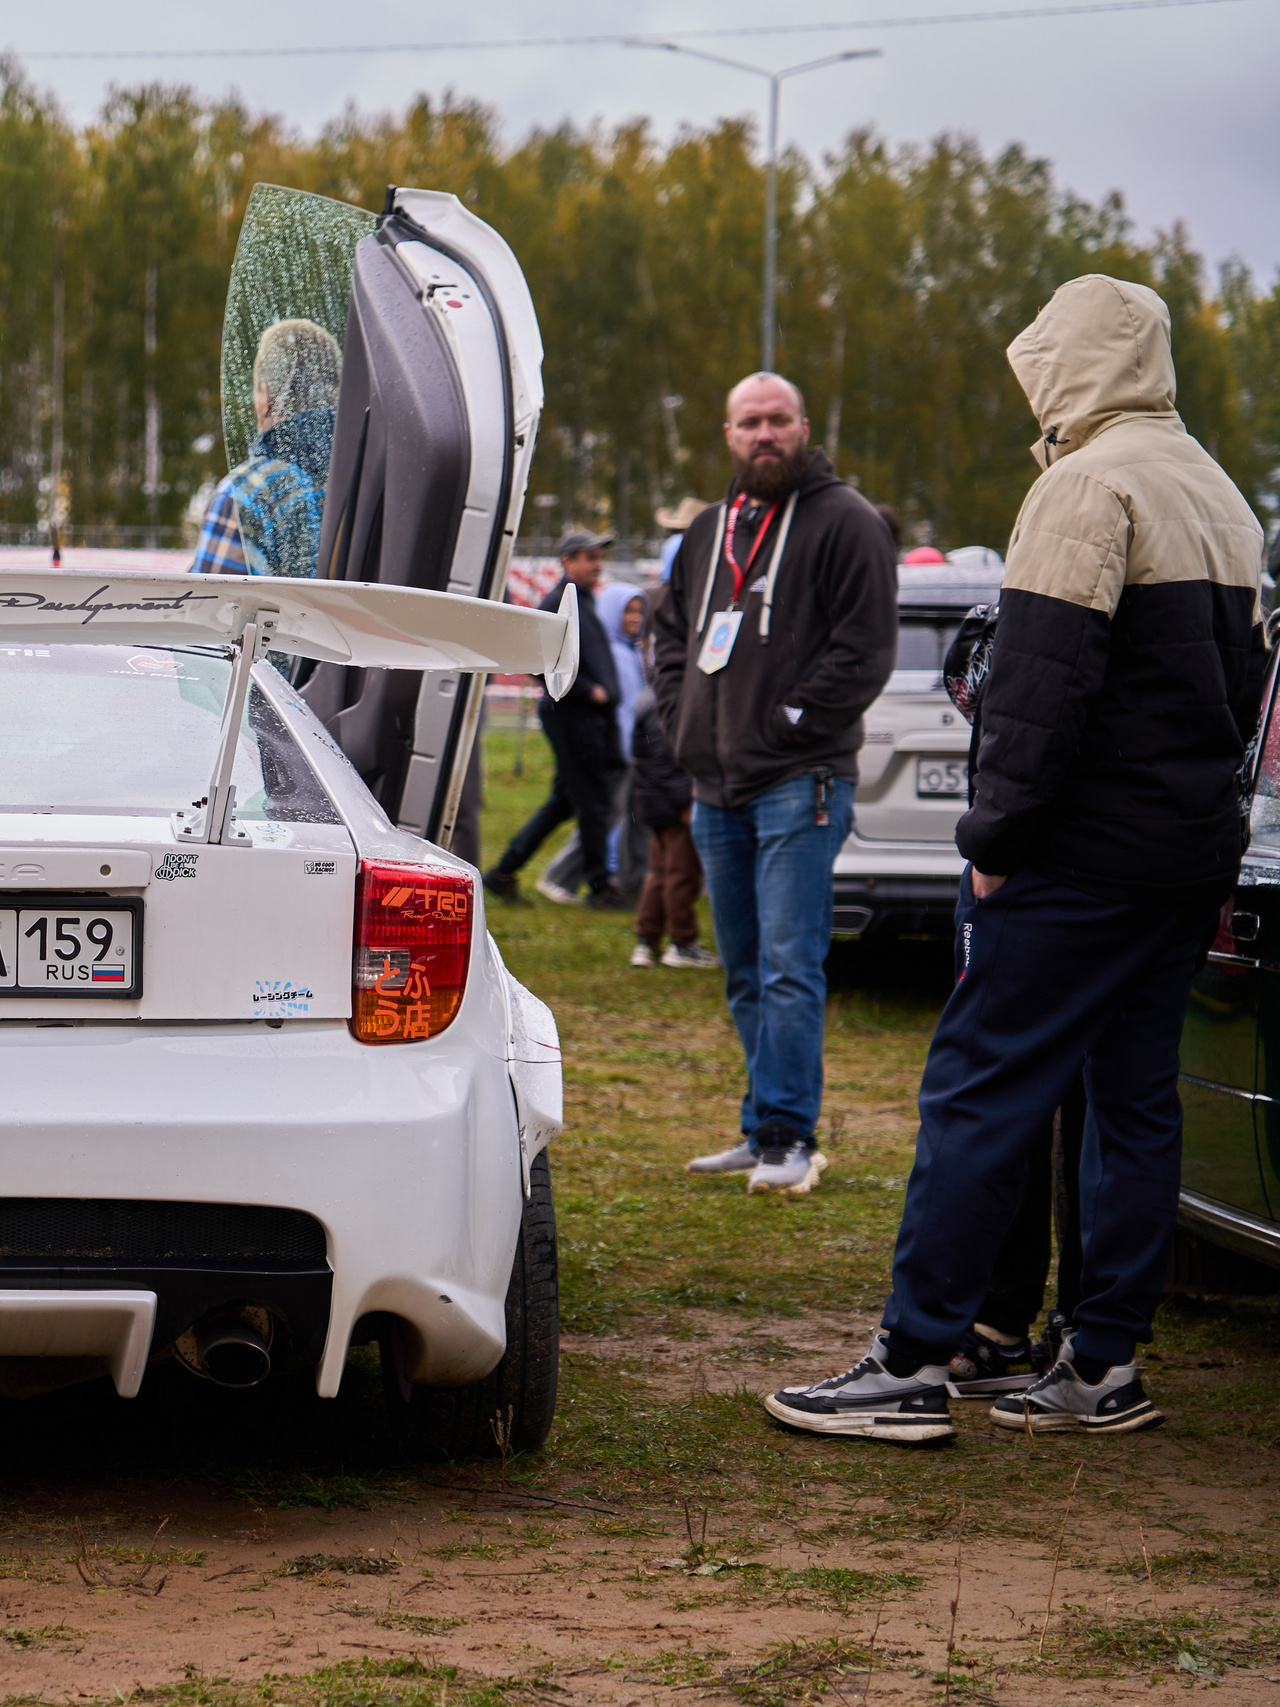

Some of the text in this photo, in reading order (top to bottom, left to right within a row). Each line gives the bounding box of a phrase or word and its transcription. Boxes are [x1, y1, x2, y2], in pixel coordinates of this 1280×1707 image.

[415, 888, 467, 914] TRD
[24, 917, 113, 962] 159
[46, 964, 90, 981] RUS
